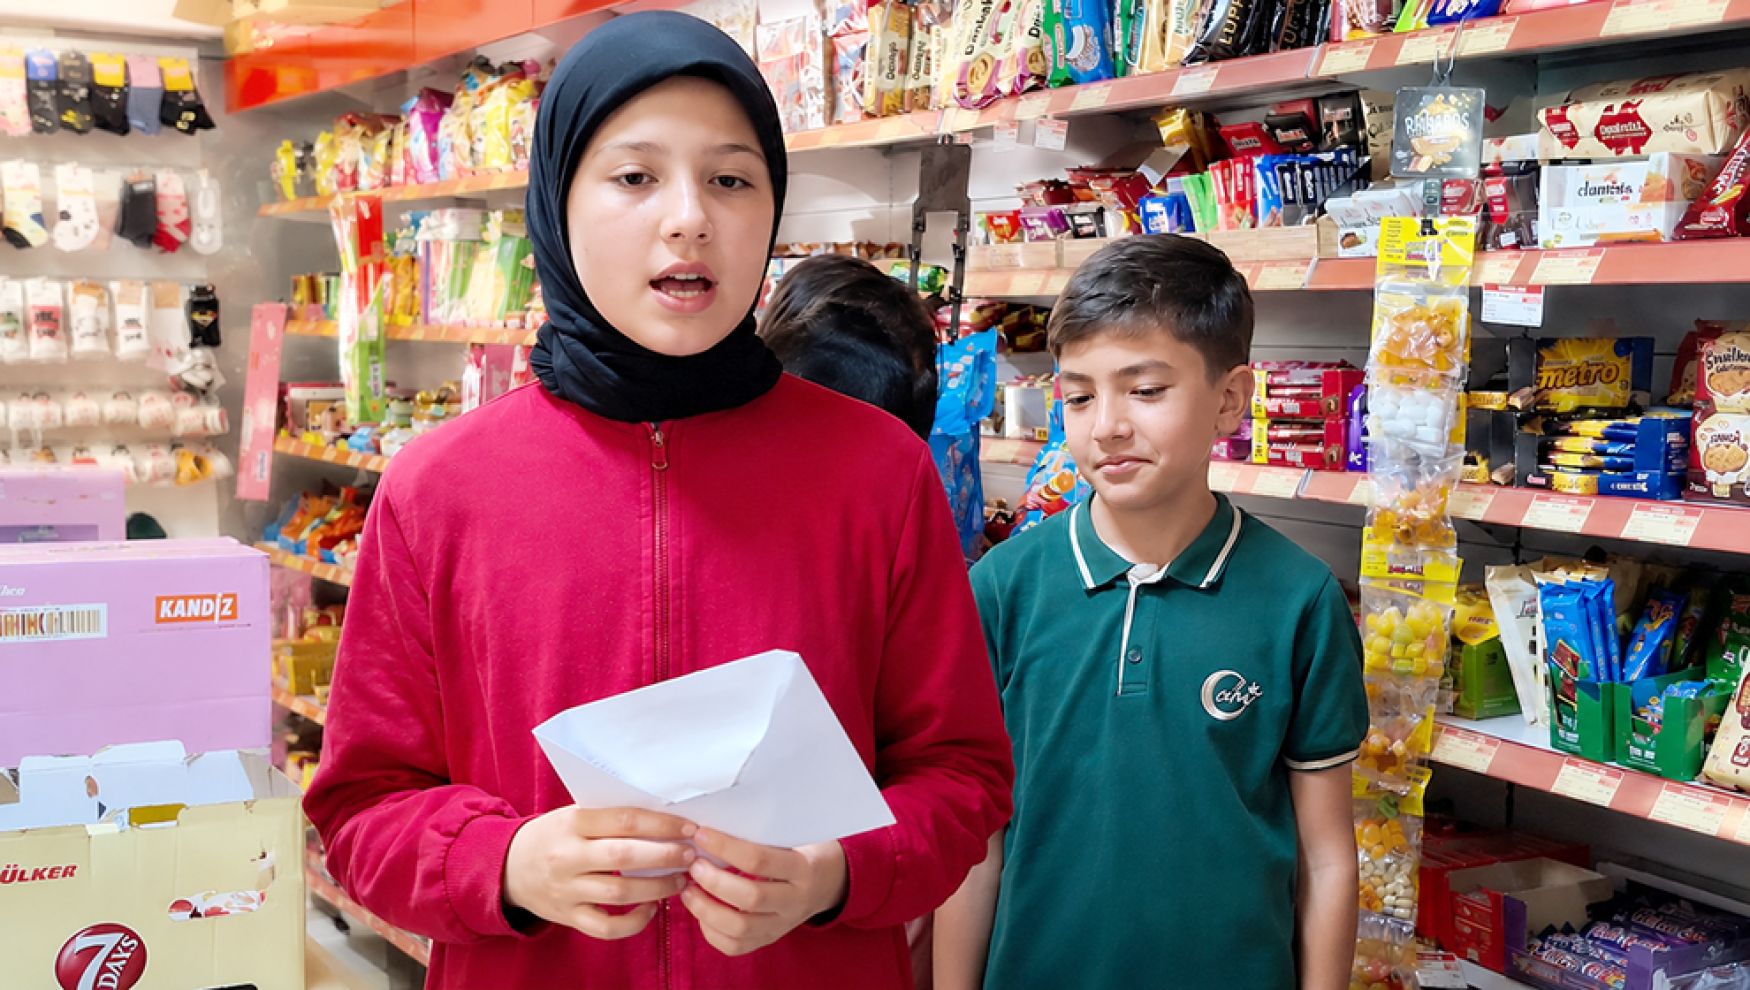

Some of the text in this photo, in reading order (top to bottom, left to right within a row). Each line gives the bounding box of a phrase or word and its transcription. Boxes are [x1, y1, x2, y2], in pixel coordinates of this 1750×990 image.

[1537, 361, 1619, 390] metro
[0, 864, 78, 884] ÜLKER
[74, 932, 125, 990] 7
[96, 935, 139, 990] DAYS
